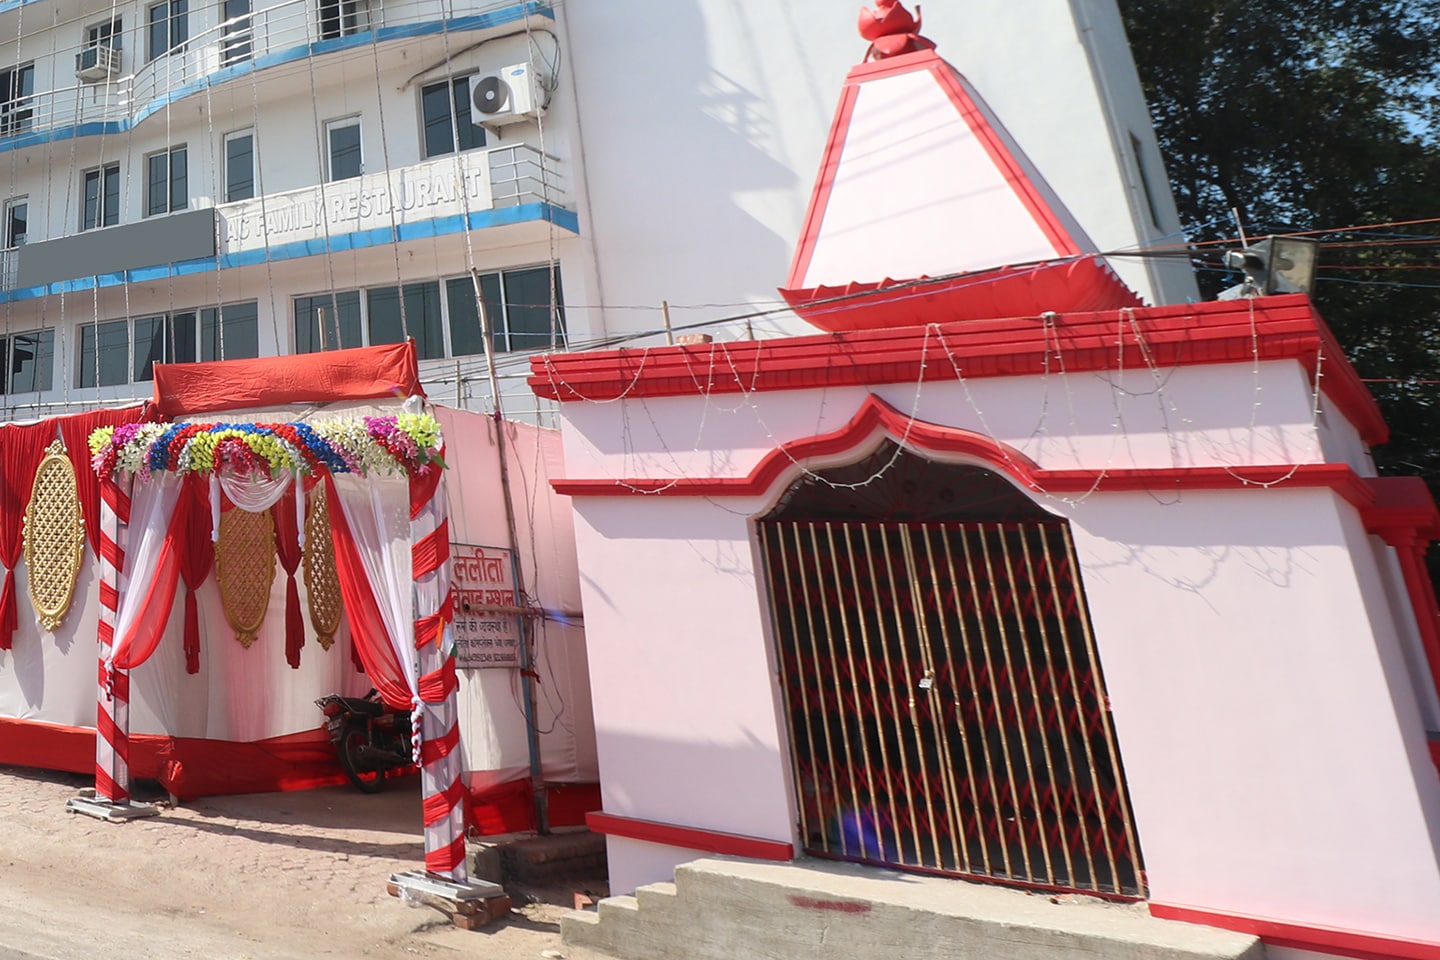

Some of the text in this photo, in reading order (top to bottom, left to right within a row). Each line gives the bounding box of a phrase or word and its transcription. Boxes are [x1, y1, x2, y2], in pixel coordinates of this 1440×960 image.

[225, 168, 481, 243] AC FAMILY RESTAURANT
[453, 548, 504, 583] ललीता
